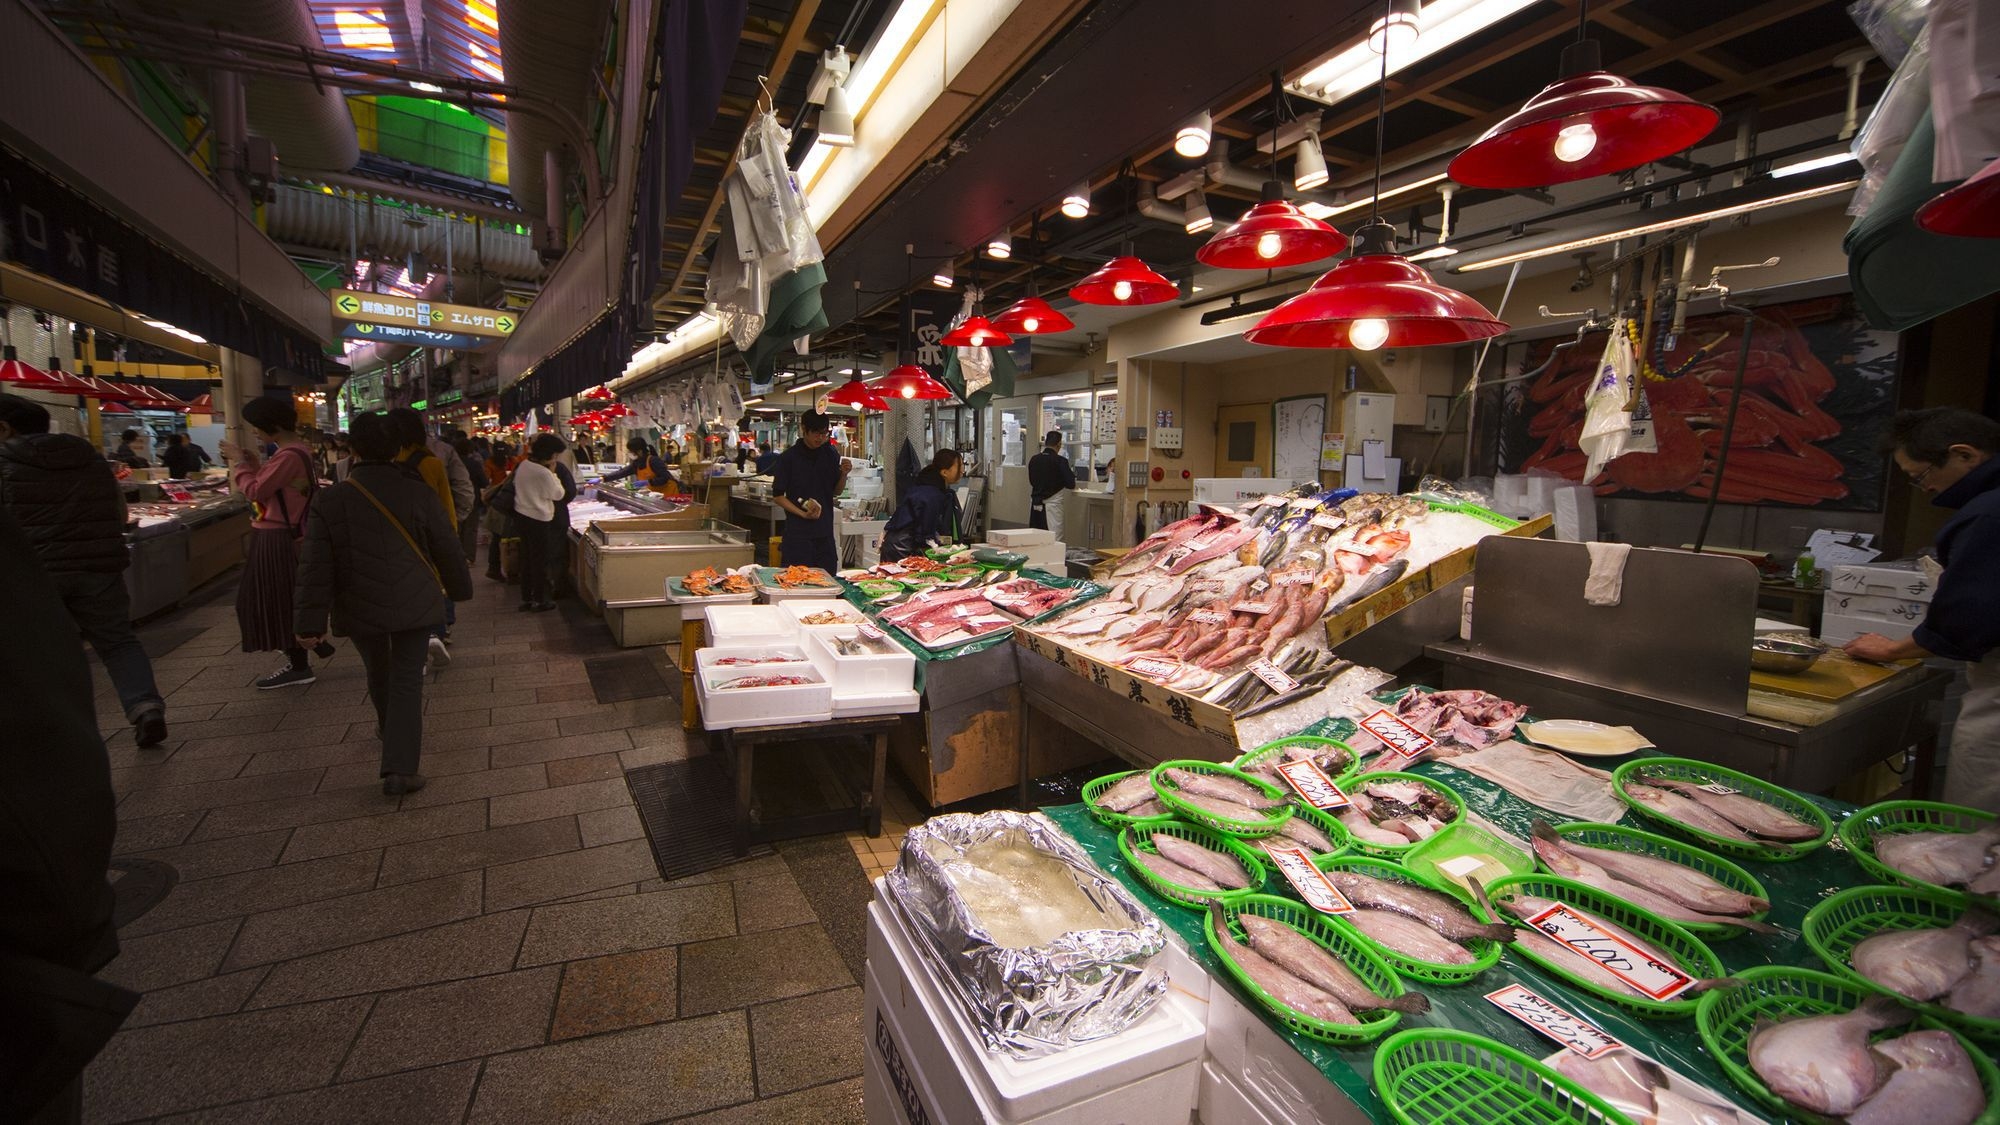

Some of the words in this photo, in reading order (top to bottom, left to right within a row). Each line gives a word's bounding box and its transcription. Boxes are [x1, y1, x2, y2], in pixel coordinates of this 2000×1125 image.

[361, 300, 416, 318] 鮮魚通り口
[451, 312, 495, 329] エムザ口
[1567, 938, 1633, 970] 600
